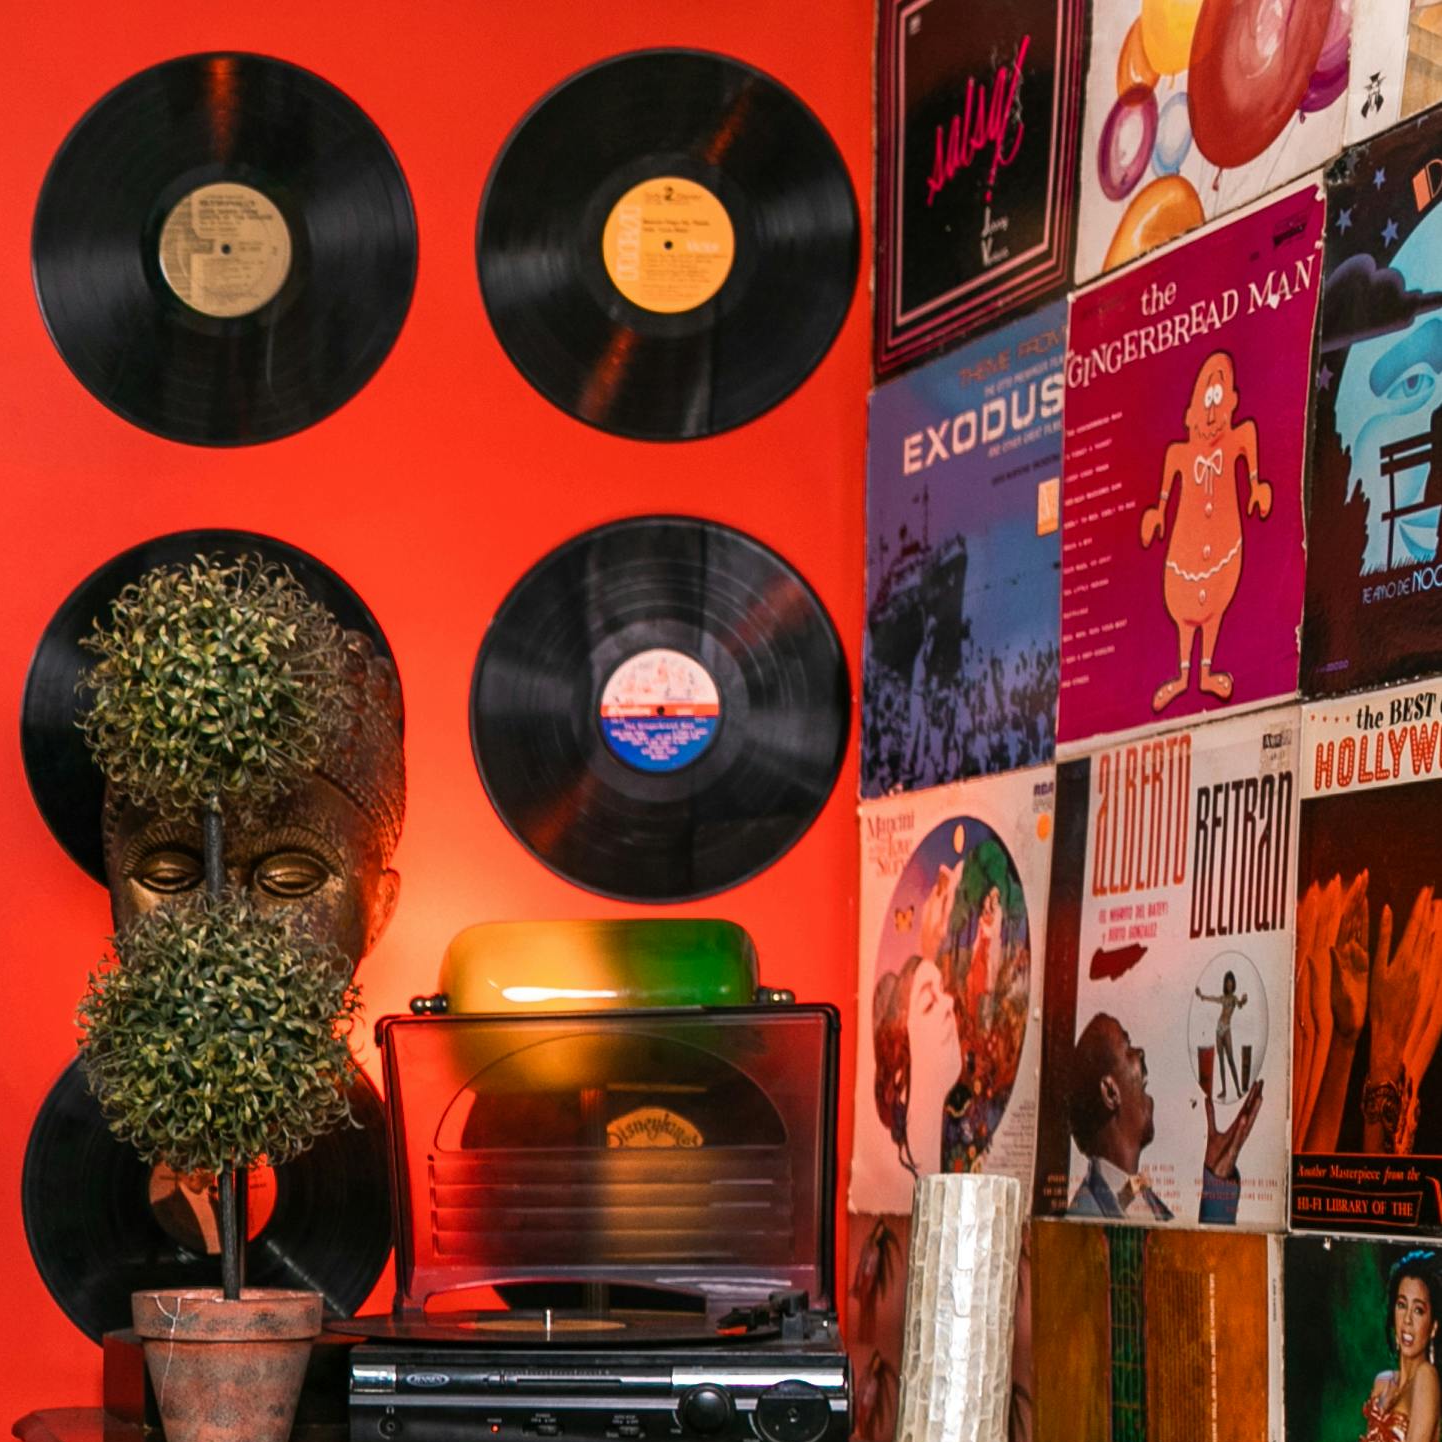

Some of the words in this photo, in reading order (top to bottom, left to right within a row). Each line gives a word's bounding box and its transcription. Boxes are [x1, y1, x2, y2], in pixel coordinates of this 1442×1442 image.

[1140, 281, 1177, 316] the
[1067, 289, 1239, 388] GINGERBREAD
[1247, 254, 1315, 314] MAN
[904, 372, 1064, 476] EXODUS
[1356, 704, 1384, 730] the
[1389, 692, 1437, 726] BEST
[1315, 721, 1442, 791] HOLLYW
[1033, 781, 1055, 797] RCA
[1297, 1164, 1326, 1177] Another
[1330, 1164, 1380, 1185] Masterpiece
[1383, 1166, 1404, 1185] from
[1407, 1166, 1421, 1180] the
[1297, 1196, 1322, 1211] HI-FI
[1326, 1197, 1369, 1215] LIBRARY
[1372, 1200, 1387, 1215] OF
[1392, 1201, 1414, 1217] THE
